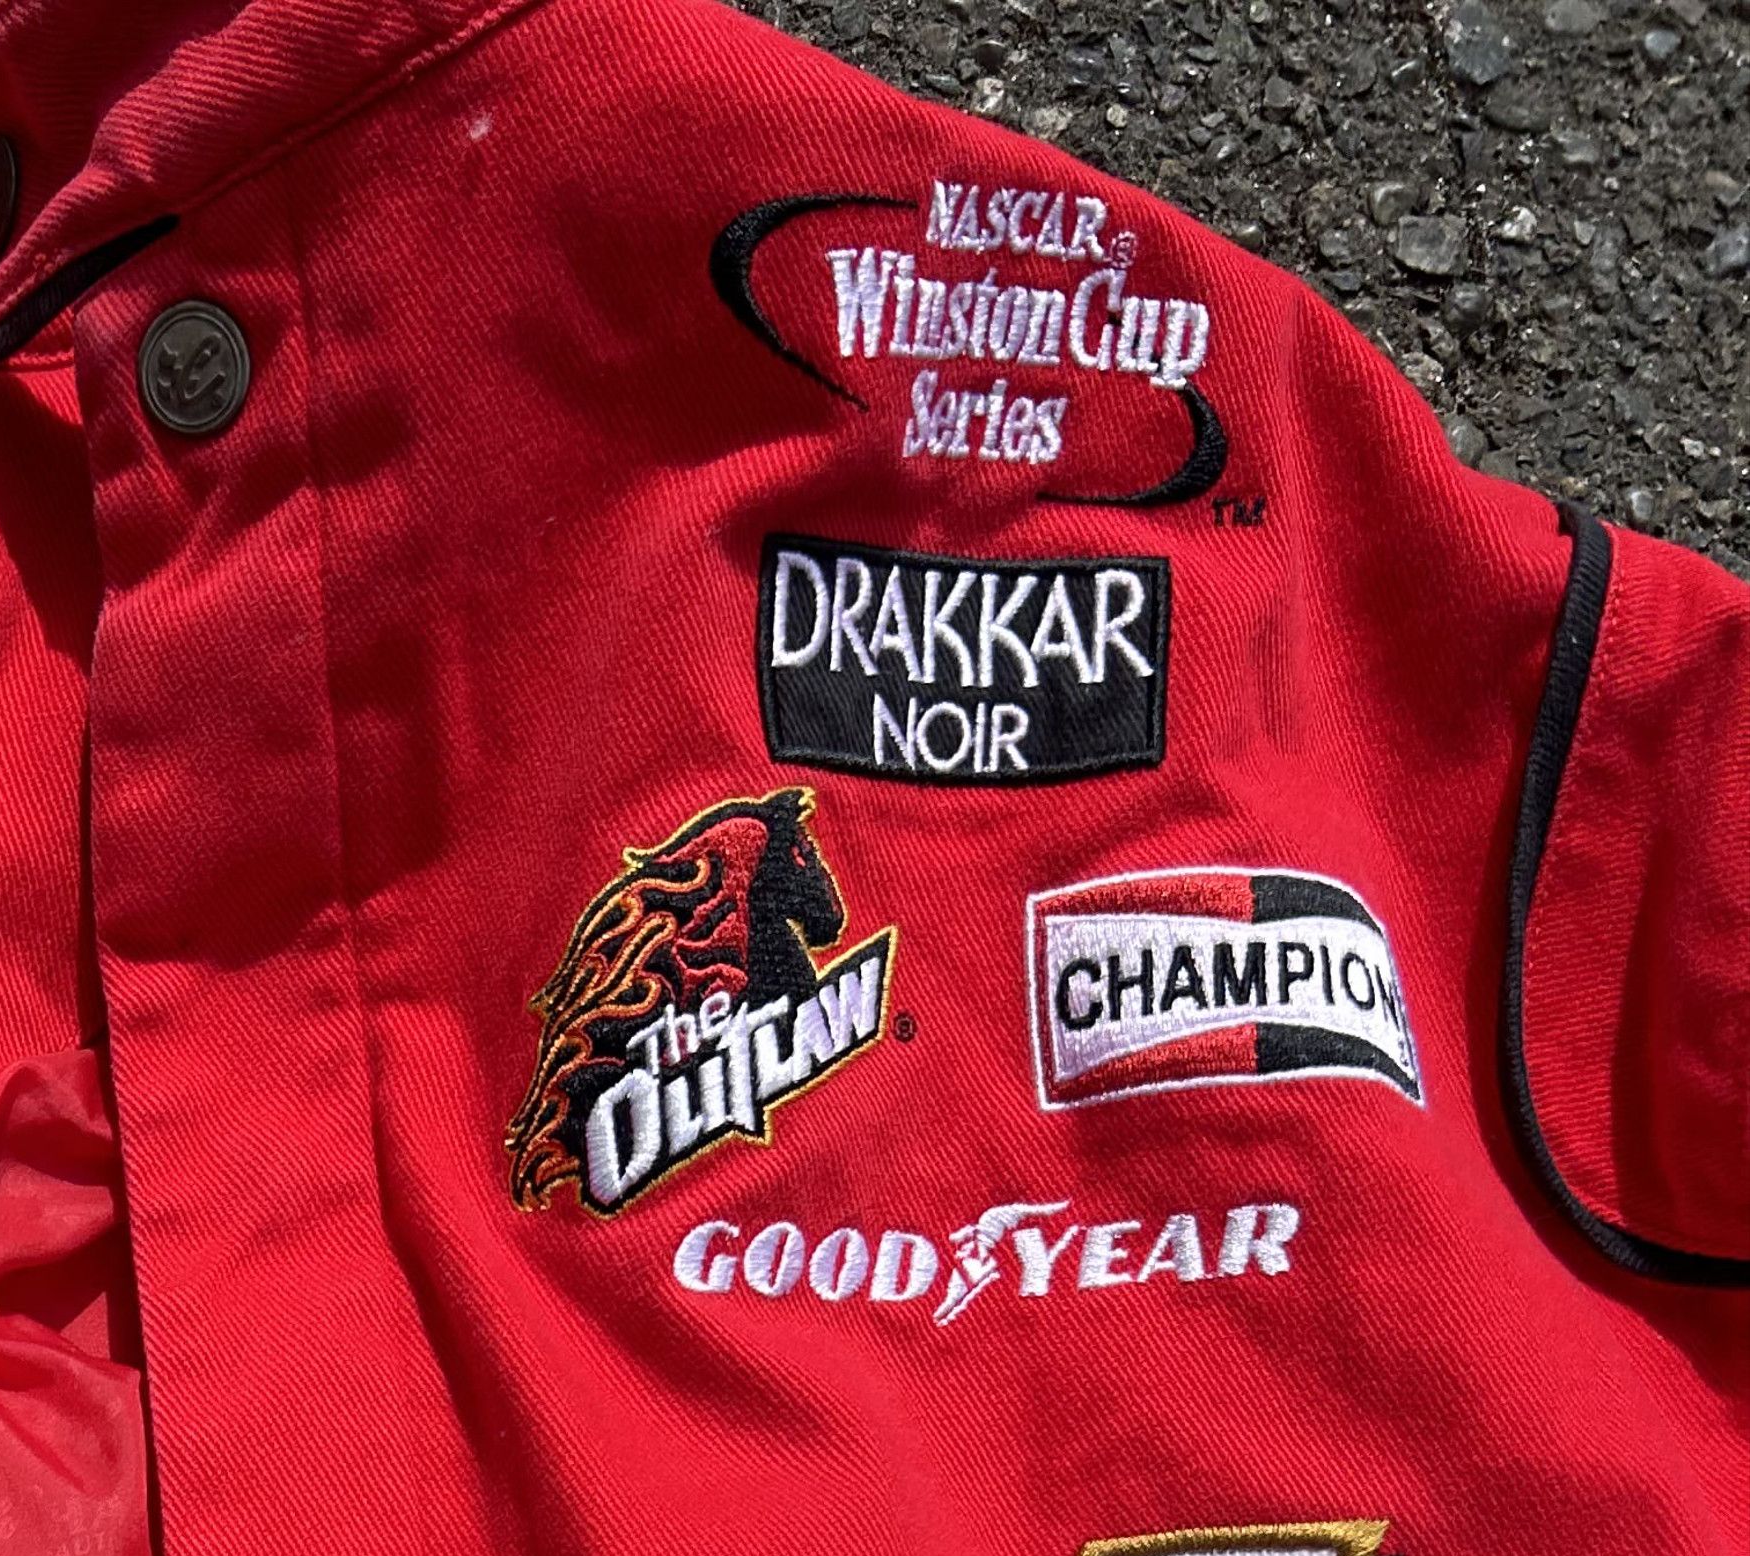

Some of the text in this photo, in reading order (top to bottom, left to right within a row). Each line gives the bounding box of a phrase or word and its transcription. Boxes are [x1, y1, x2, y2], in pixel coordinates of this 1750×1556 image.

[925, 179, 1112, 263] NASCAR
[825, 247, 1211, 390] Winston Cup
[902, 368, 1069, 465] Series
[771, 551, 1155, 689] DRAKKAR
[871, 692, 1031, 773] NOIR
[1054, 940, 1405, 1034] CHAMPION
[624, 990, 732, 1080] The
